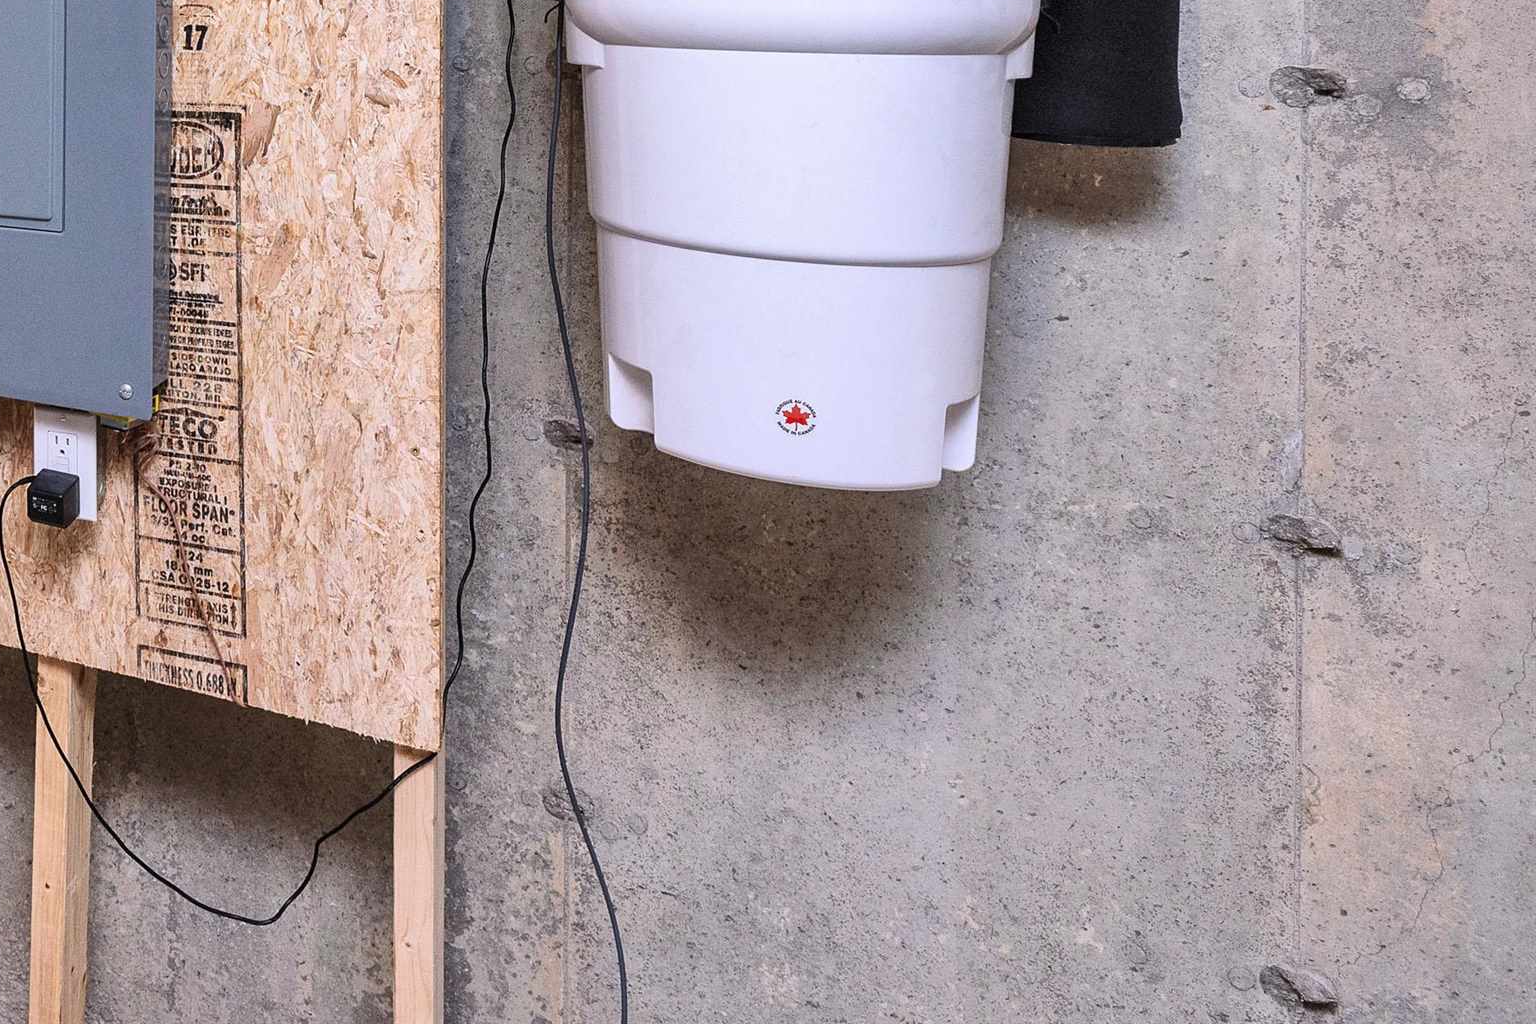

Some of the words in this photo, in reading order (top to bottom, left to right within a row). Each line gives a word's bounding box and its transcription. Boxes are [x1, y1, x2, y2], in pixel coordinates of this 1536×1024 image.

[182, 24, 209, 51] 17
[158, 415, 218, 439] TECO
[159, 477, 211, 492] EXPOSURE
[157, 486, 222, 505] TRUCTURAL
[152, 568, 176, 583] CSA
[193, 566, 214, 577] mm
[158, 603, 175, 615] HIS
